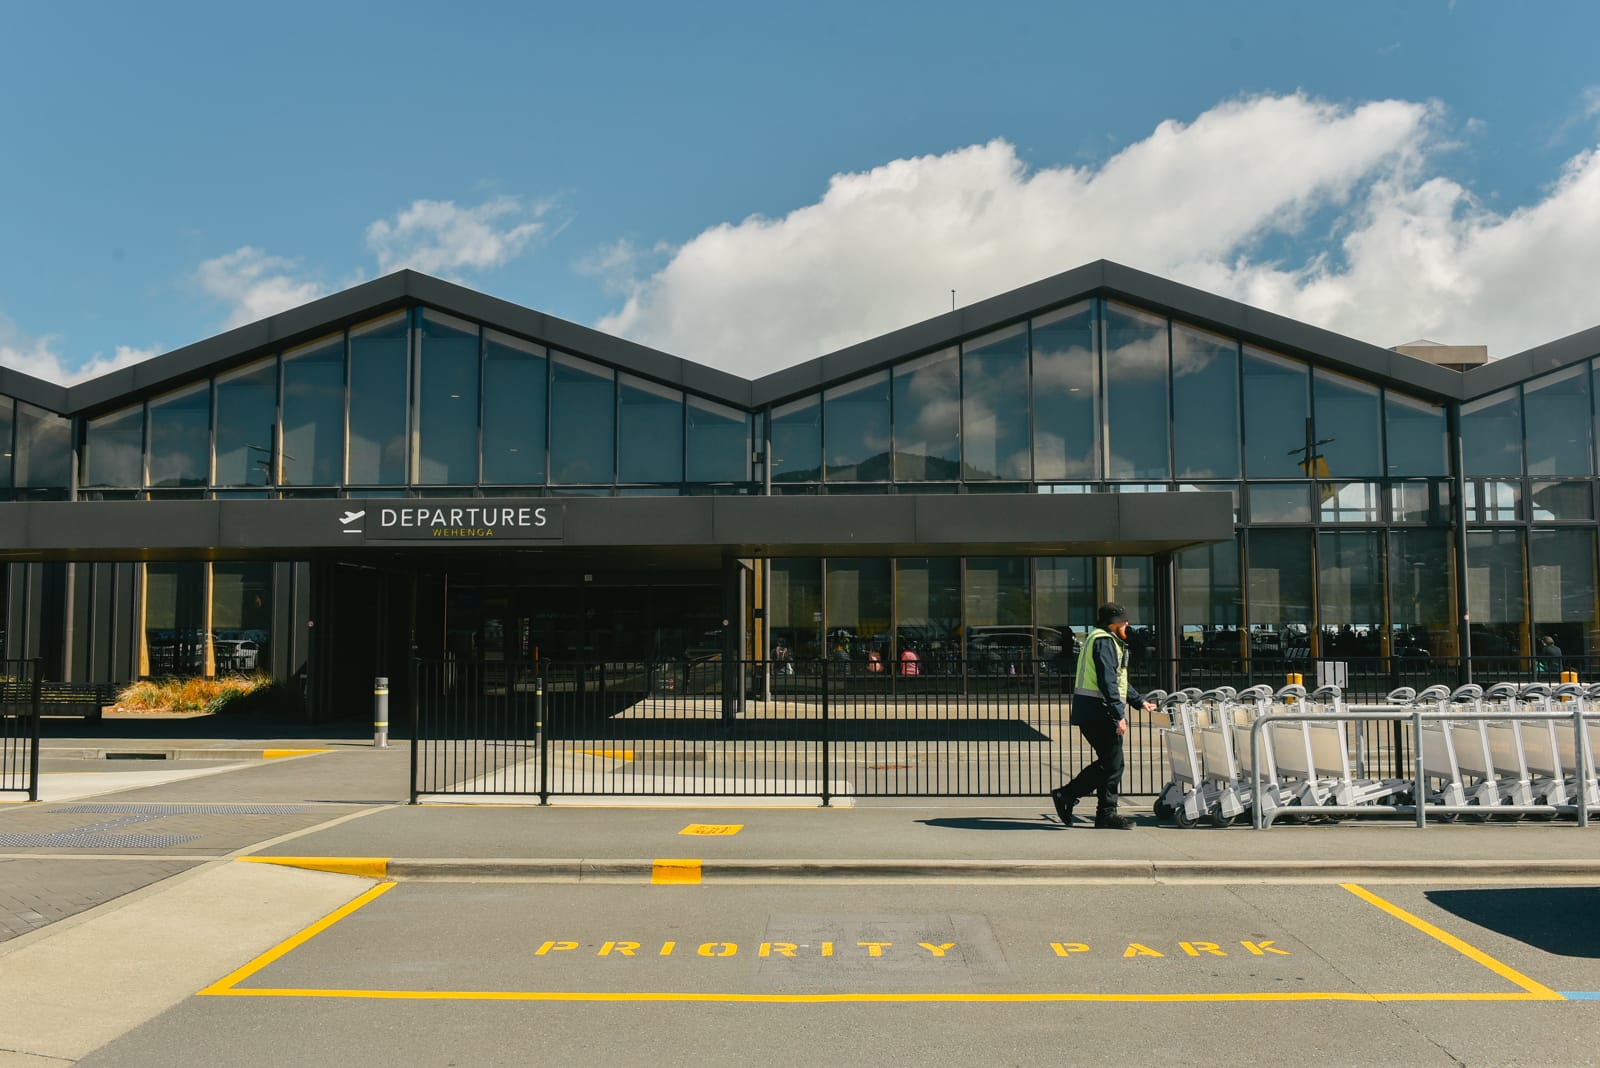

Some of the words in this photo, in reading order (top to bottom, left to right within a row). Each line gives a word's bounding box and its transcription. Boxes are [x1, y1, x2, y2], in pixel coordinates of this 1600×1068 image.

[381, 508, 547, 527] DEPARTURES
[432, 528, 493, 537] WEHENGA
[535, 941, 956, 957] PRIORITY
[1049, 940, 1291, 958] PARK
